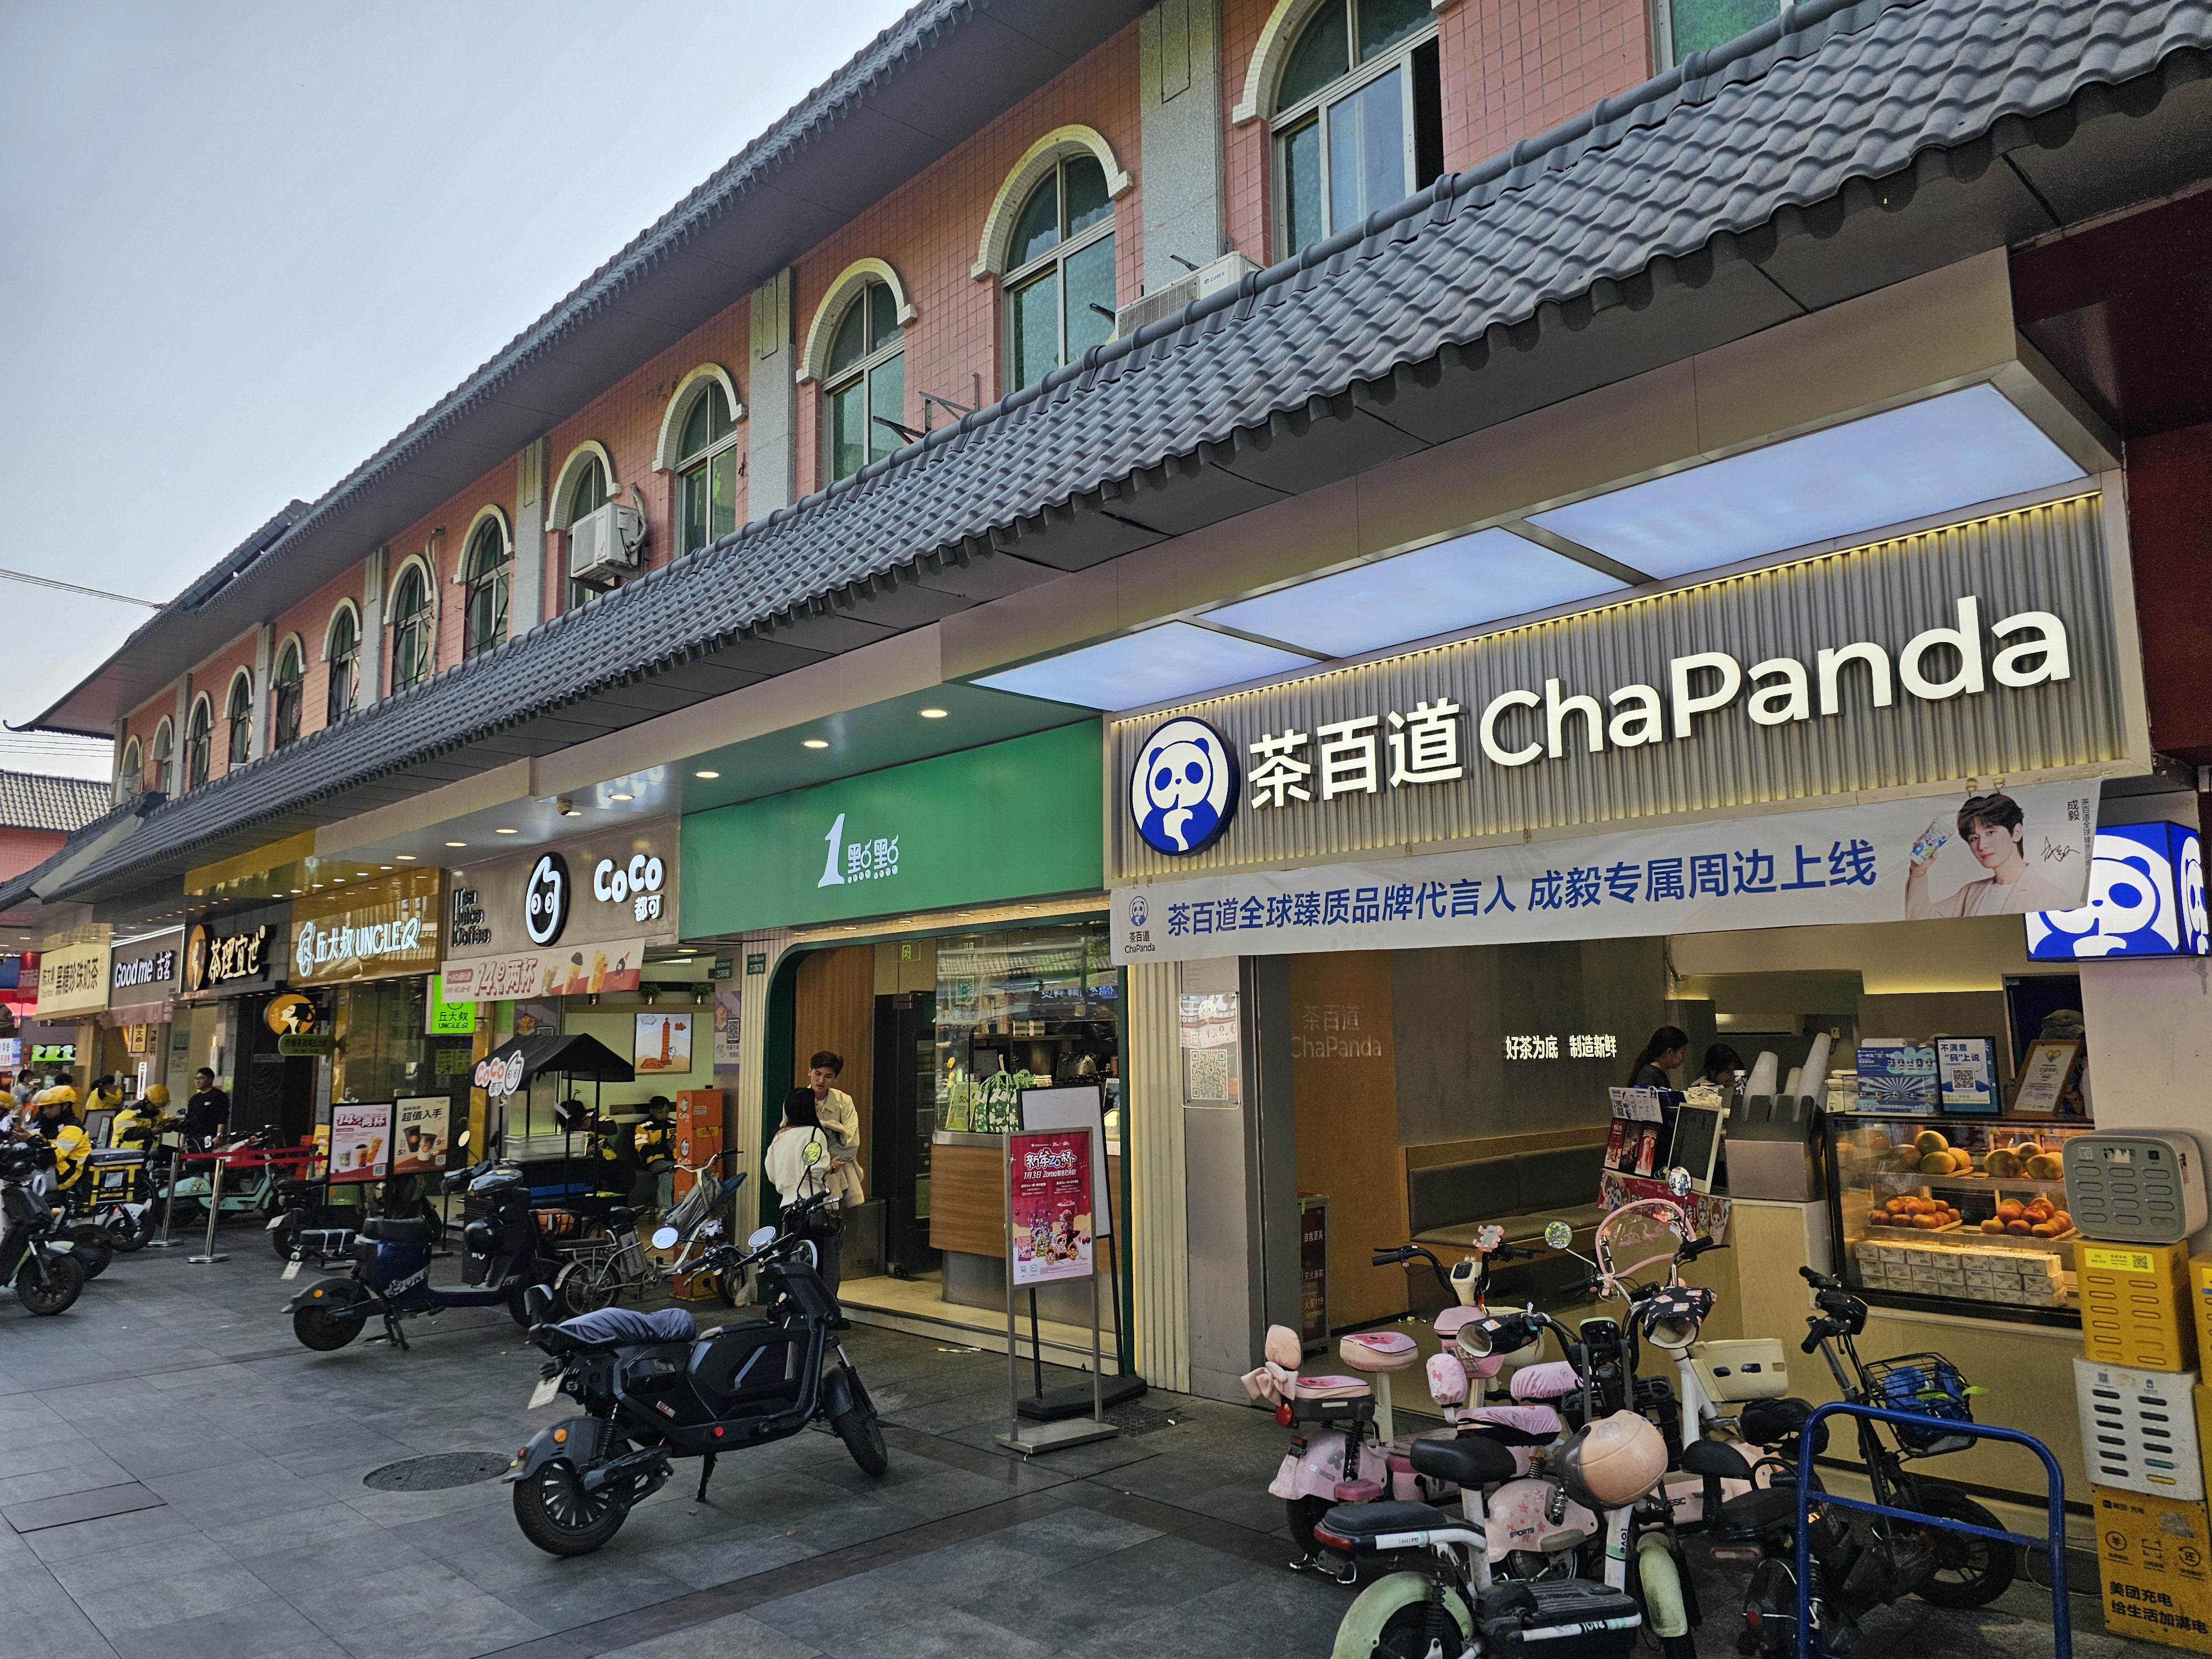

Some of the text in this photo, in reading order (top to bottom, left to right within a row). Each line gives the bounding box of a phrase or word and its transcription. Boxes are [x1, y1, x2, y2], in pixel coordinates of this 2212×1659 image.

[1248, 596, 2070, 809] 茶百道 ChaPanda
[2068, 800, 2080, 821] 成毅
[593, 854, 663, 902] CoCo
[1167, 839, 1876, 937] 茶百道全球臻质品牌代言人 成毅专属周边上线
[454, 888, 478, 907] Tea
[634, 895, 661, 922] 都可
[315, 925, 356, 963] 丘大叔
[452, 926, 492, 947] Coffee
[1125, 943, 1155, 953] ChaPanda
[1129, 931, 1150, 942] 茶百道
[156, 951, 172, 981] 古茗
[438, 1011, 468, 1022] 丘大叔
[1303, 1004, 1361, 1031] 茶百道
[1291, 1034, 1381, 1058] ChaPanda
[1506, 1034, 1618, 1060] 好茶为底 制造新鲜
[1940, 1044, 1967, 1052] 不满意
[476, 1060, 506, 1086] CoCo
[401, 1108, 442, 1123] 超值入手
[1024, 1171, 1042, 1180] 1月3日
[1510, 1527, 1535, 1538] SPORTS
[1619, 1528, 1628, 1554] love
[2109, 1580, 2173, 1608] 美团充电
[2111, 1600, 2208, 1635] 给生活加满电
